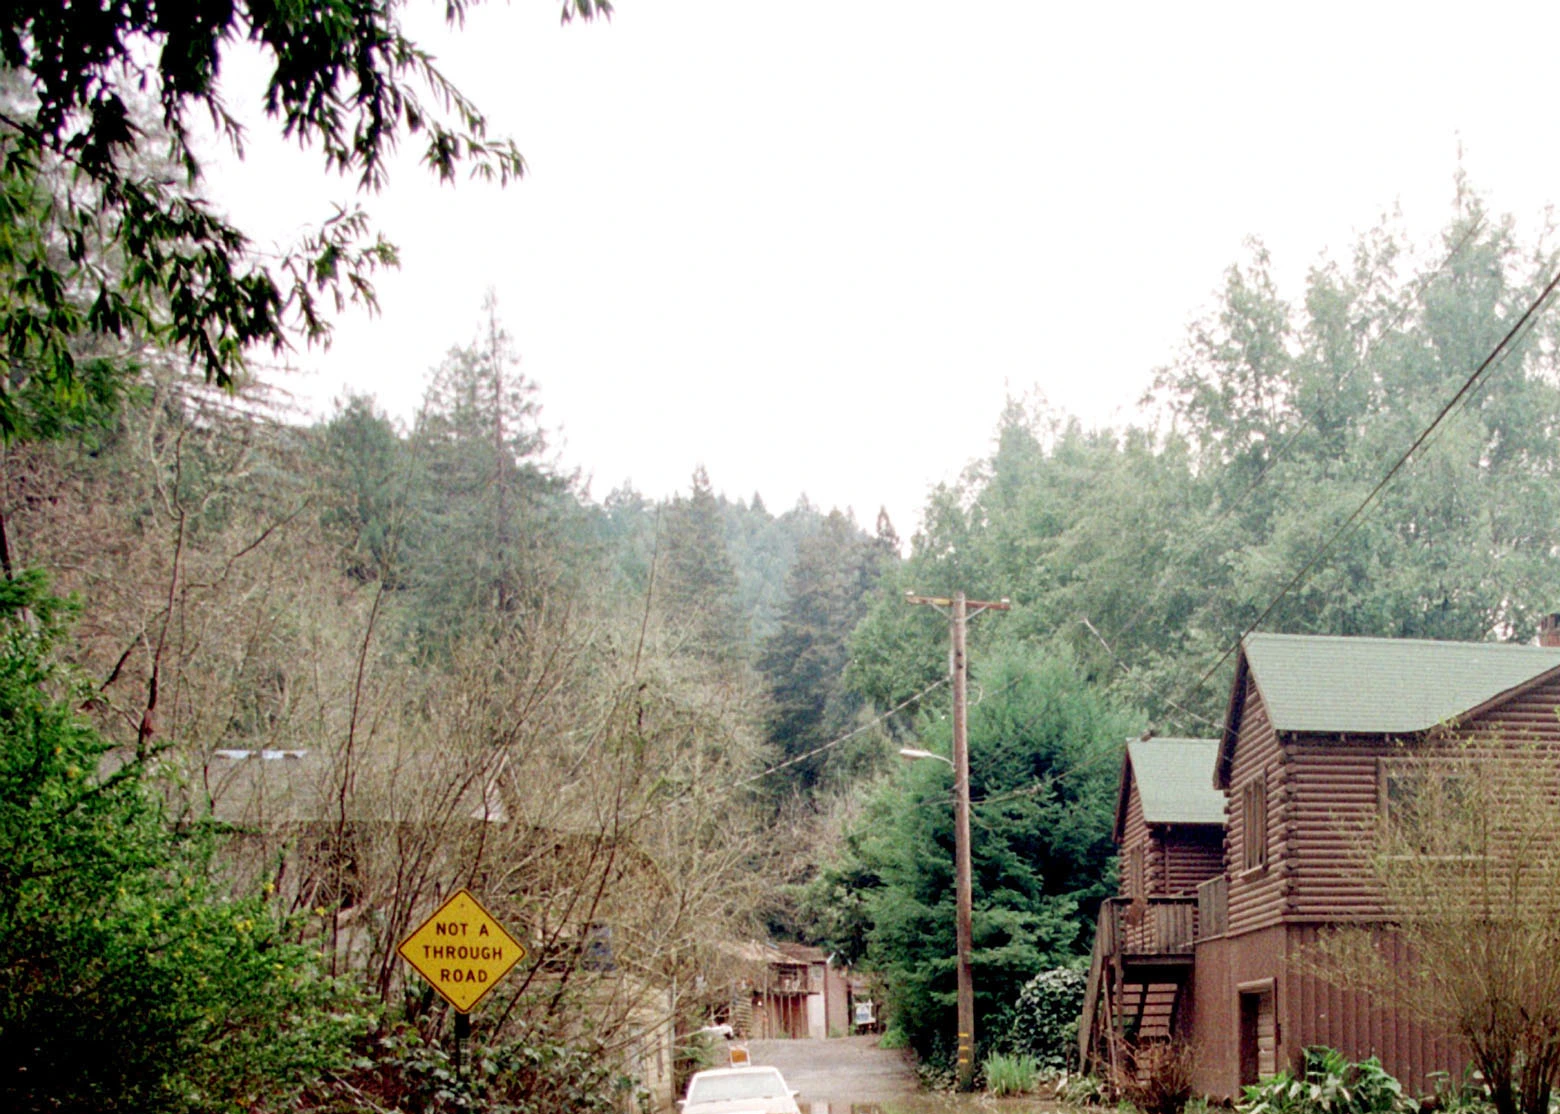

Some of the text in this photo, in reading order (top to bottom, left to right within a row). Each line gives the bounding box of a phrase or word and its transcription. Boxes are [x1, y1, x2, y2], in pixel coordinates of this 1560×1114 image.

[436, 922, 489, 936] NOT A
[422, 945, 502, 960] THROUGH
[440, 969, 488, 983] ROAD
